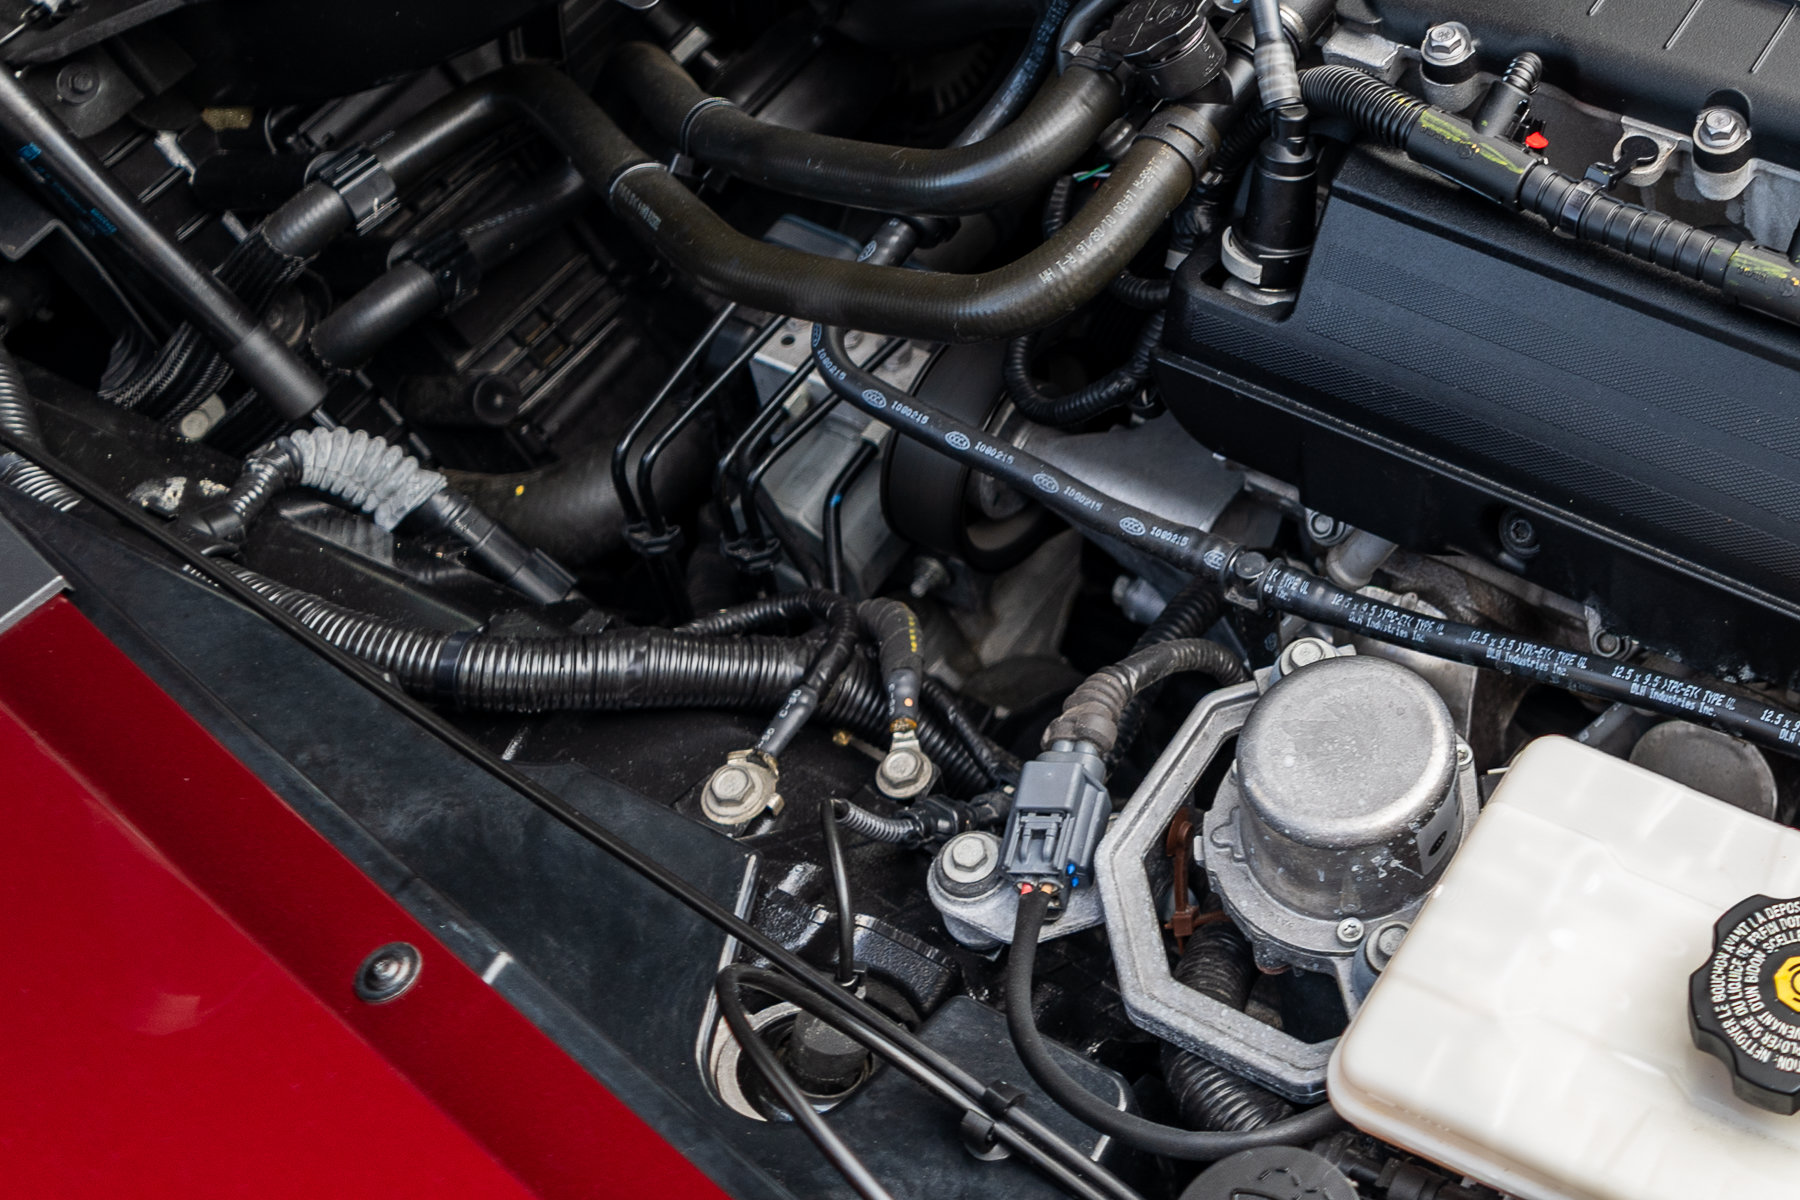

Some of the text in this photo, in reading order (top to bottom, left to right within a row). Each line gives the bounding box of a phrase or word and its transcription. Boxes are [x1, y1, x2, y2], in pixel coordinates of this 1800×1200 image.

[1468, 630, 1490, 645] 12.5
[1497, 637, 1516, 651] 9.5
[1554, 651, 1578, 666] TYPE
[1504, 653, 1550, 672] Industries
[1611, 665, 1635, 680] 12.5
[1642, 673, 1661, 688] 9.5
[1702, 690, 1726, 706] TYPE
[1648, 687, 1697, 711] Industries
[1698, 701, 1717, 718] Inc.
[1759, 708, 1784, 725] 12.5
[1778, 728, 1798, 744] DLH
[1747, 911, 1767, 928] LA
[1721, 921, 1752, 953] AVANT
[1746, 920, 1780, 946] FREIN
[1735, 943, 1754, 958] DE
[1710, 951, 1731, 1003] BOUCHON
[1727, 957, 1747, 1000] LIQUIDE
[1744, 950, 1767, 984] BIDON
[1713, 1003, 1732, 1019] LE
[1730, 1000, 1749, 1017] DU
[1721, 1017, 1772, 1063] NETTOYER
[1740, 1015, 1764, 1039] QUE
